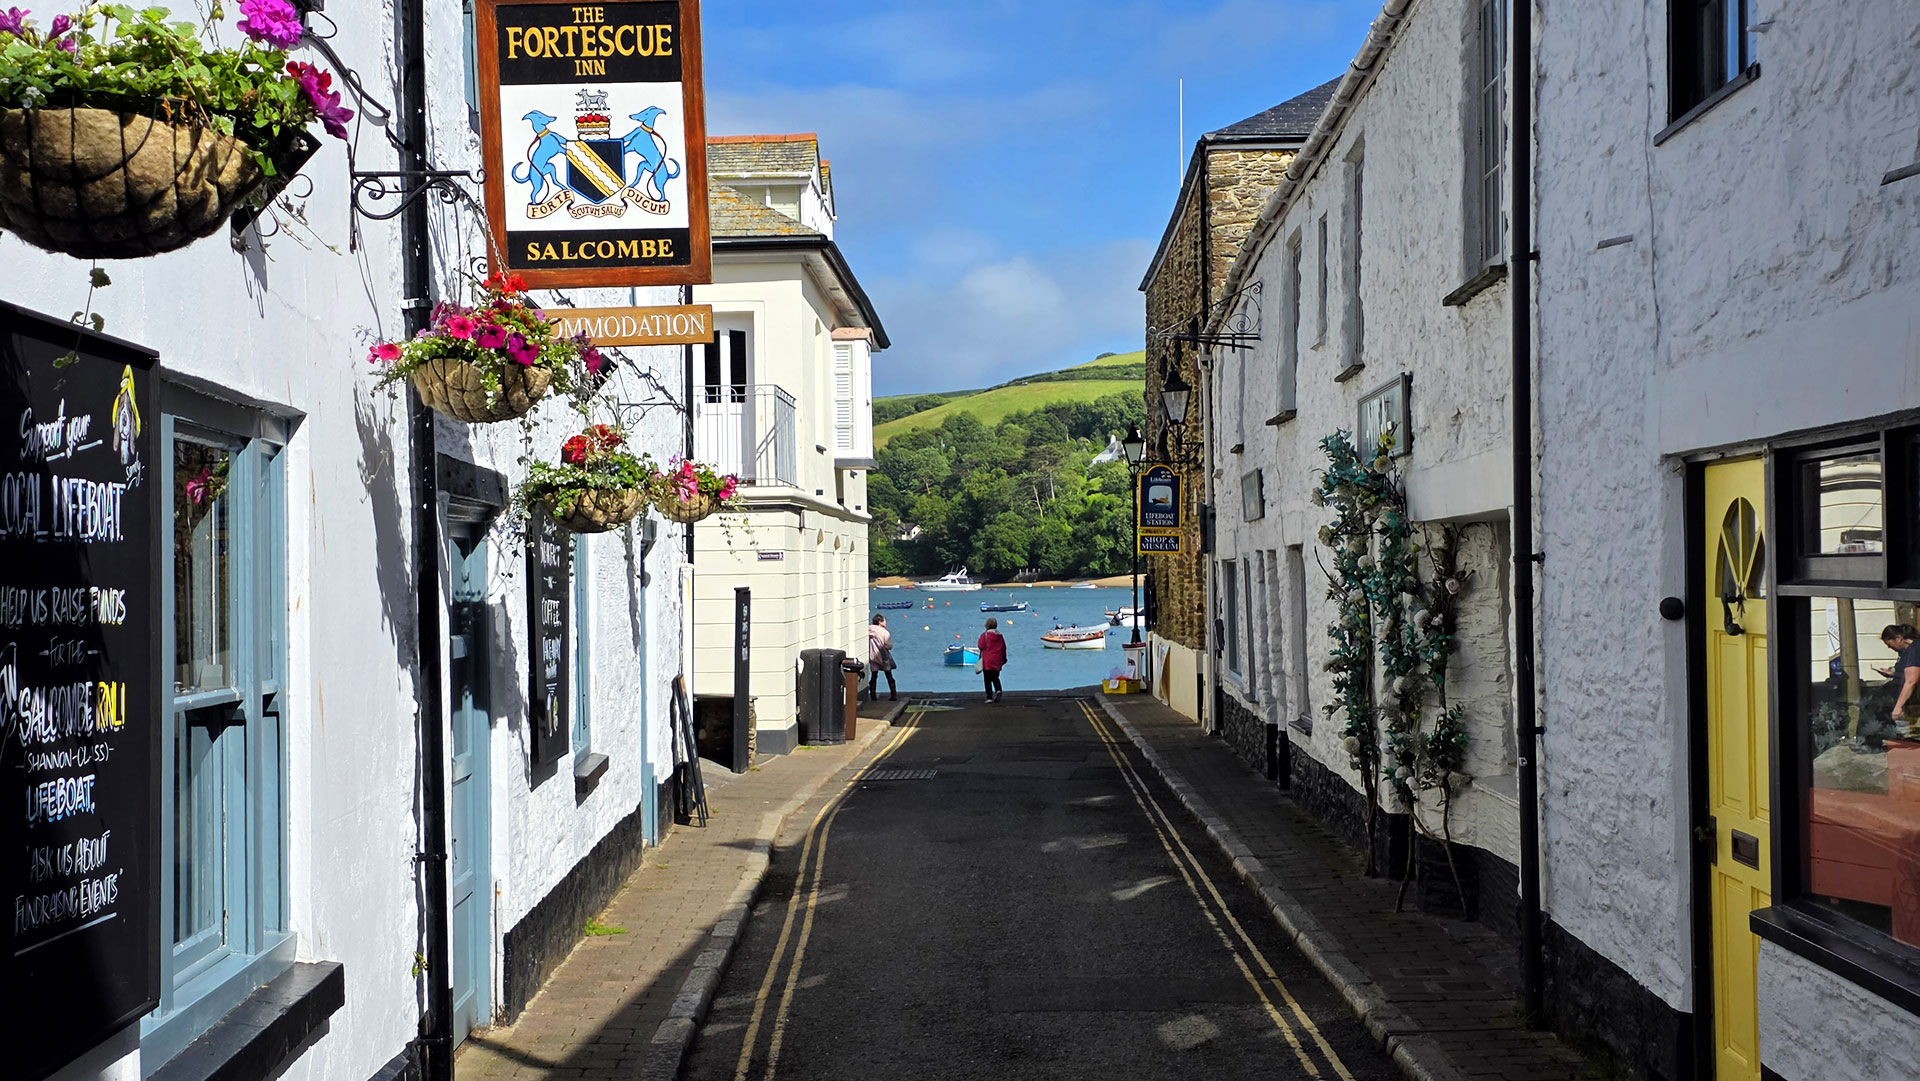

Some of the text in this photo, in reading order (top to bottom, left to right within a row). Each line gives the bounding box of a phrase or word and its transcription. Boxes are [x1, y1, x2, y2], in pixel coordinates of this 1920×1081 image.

[572, 7, 604, 23] THE
[505, 24, 673, 59] FORTESCUE
[575, 59, 606, 76] INN
[531, 190, 571, 217] FORTE
[601, 205, 623, 217] SALUS
[627, 189, 666, 213] DUCUM
[527, 238, 674, 261] SALCOMBE
[549, 312, 705, 340] OMMODATION
[0, 471, 48, 536] OCAL
[0, 586, 127, 626] HELP US RAISE FUNDS
[19, 681, 126, 745] SALCOMBE RNLI
[56, 843, 73, 875] US
[74, 830, 111, 873] ABOUT
